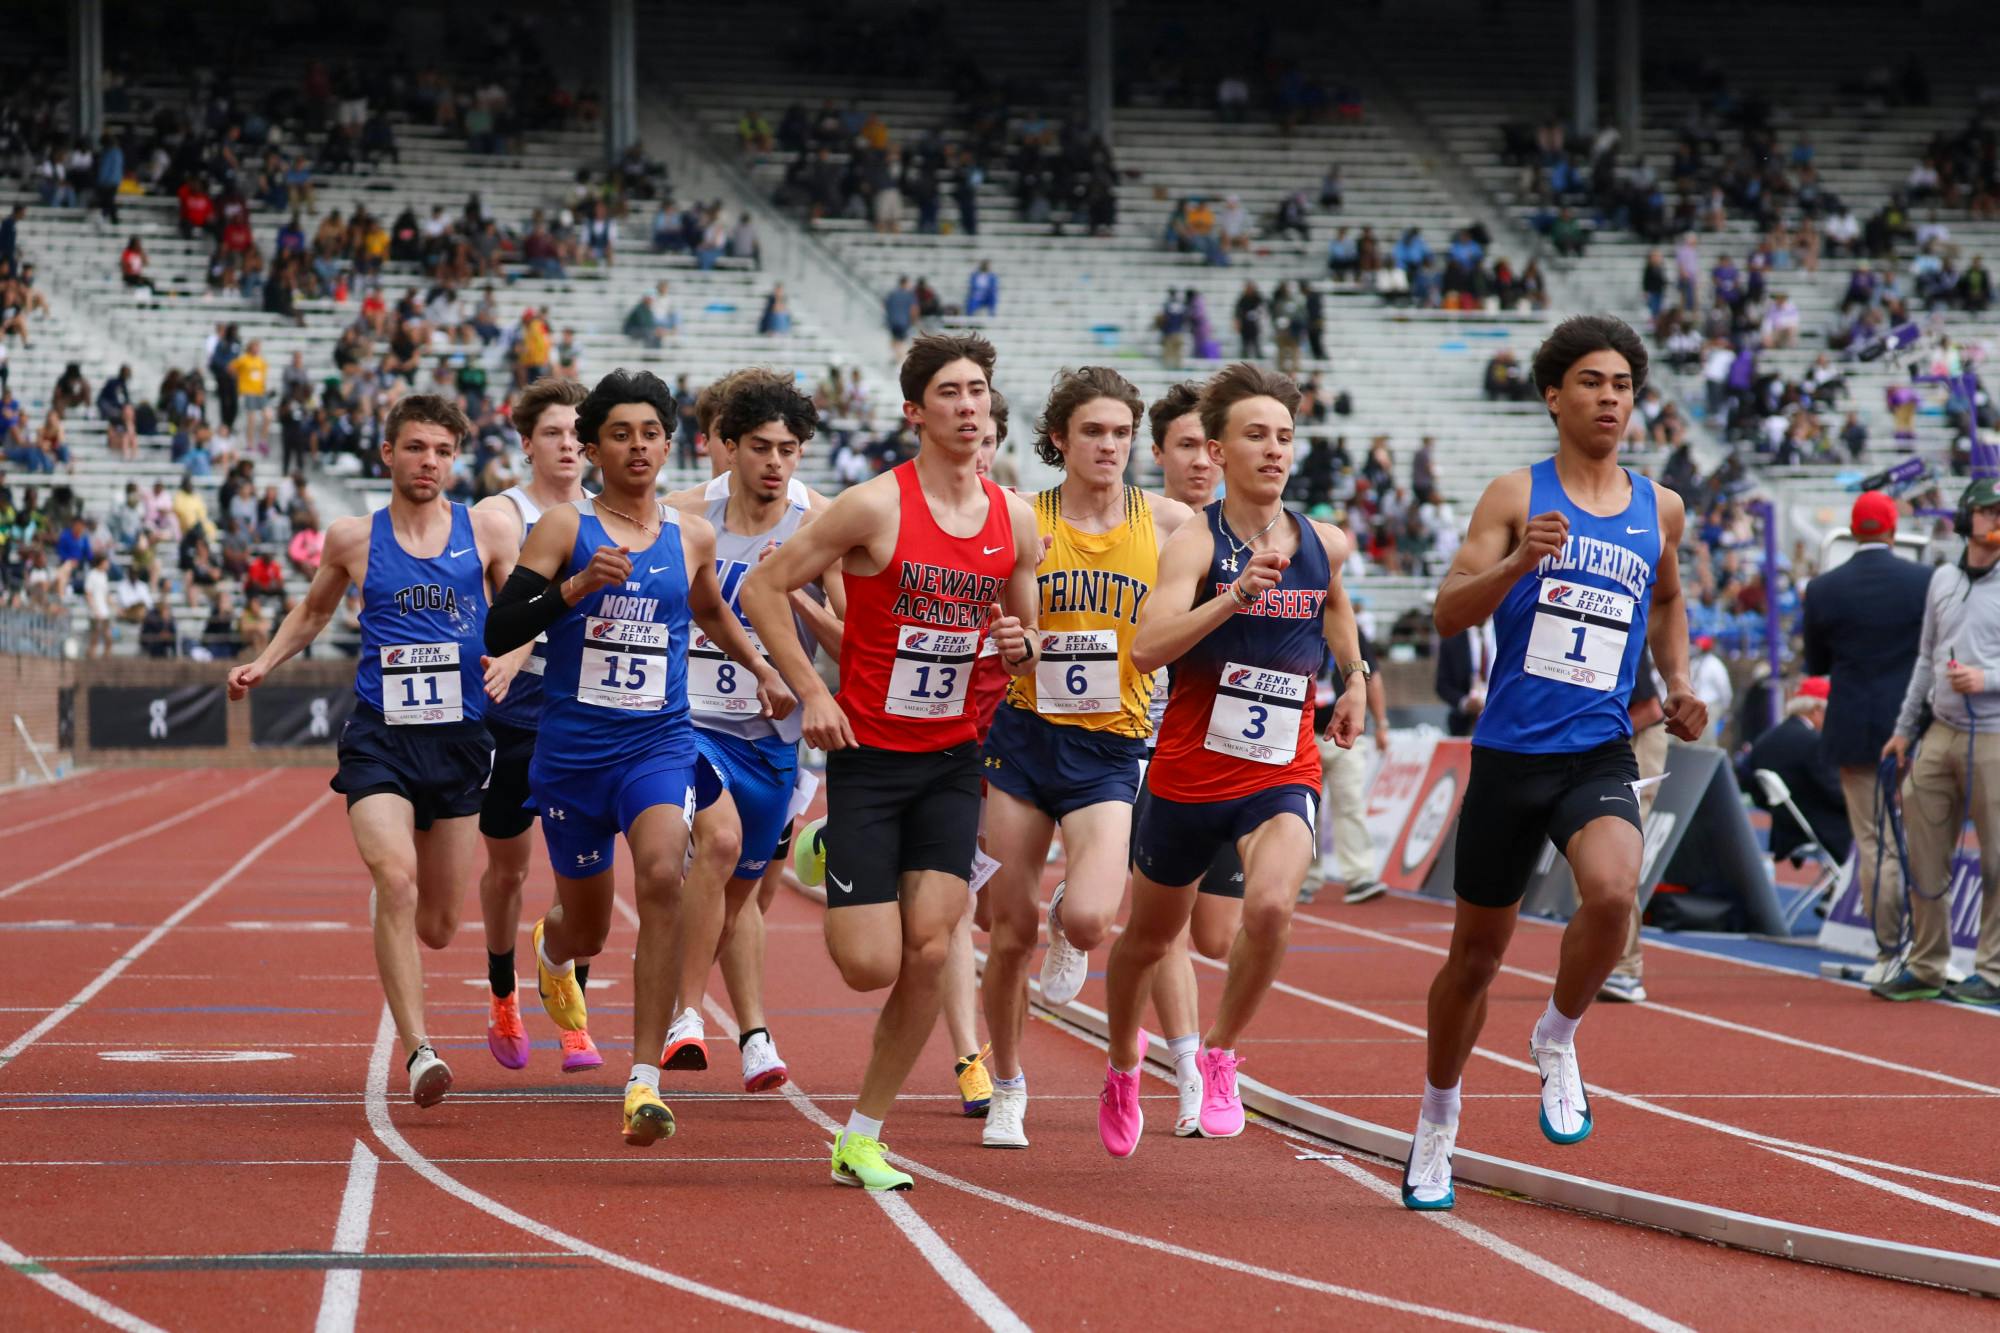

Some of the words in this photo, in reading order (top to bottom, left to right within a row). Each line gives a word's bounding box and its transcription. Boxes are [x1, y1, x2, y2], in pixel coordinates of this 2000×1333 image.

[394, 584, 458, 616] TOGA
[1037, 570, 1148, 624] TRINITY
[1216, 583, 1328, 619] RSHEY
[1580, 590, 1614, 605] PENN
[599, 594, 659, 622] NORTH
[1576, 600, 1623, 617] RELAYS
[623, 624, 652, 635] PENN
[619, 633, 660, 644] RELAYS
[936, 635, 967, 644] PENN
[1066, 635, 1098, 643] PENN
[1565, 626, 1588, 663] 1
[411, 647, 440, 655] PENN
[932, 643, 971, 653] RELAYS
[1065, 643, 1108, 651] RELAYS
[410, 655, 450, 664] RELAYS
[601, 656, 648, 690] 15
[716, 664, 737, 694] 8
[1066, 664, 1088, 695] 6
[1258, 672, 1291, 686] PENN
[1544, 665, 1571, 675] AMERICA
[1571, 668, 1596, 683] 250
[910, 666, 957, 699] 13
[1254, 682, 1298, 697] RELAYS
[401, 675, 443, 706] 11
[725, 699, 747, 711] 250
[928, 703, 949, 715] 250
[1241, 705, 1268, 740] 3
[1248, 745, 1273, 760] 250
